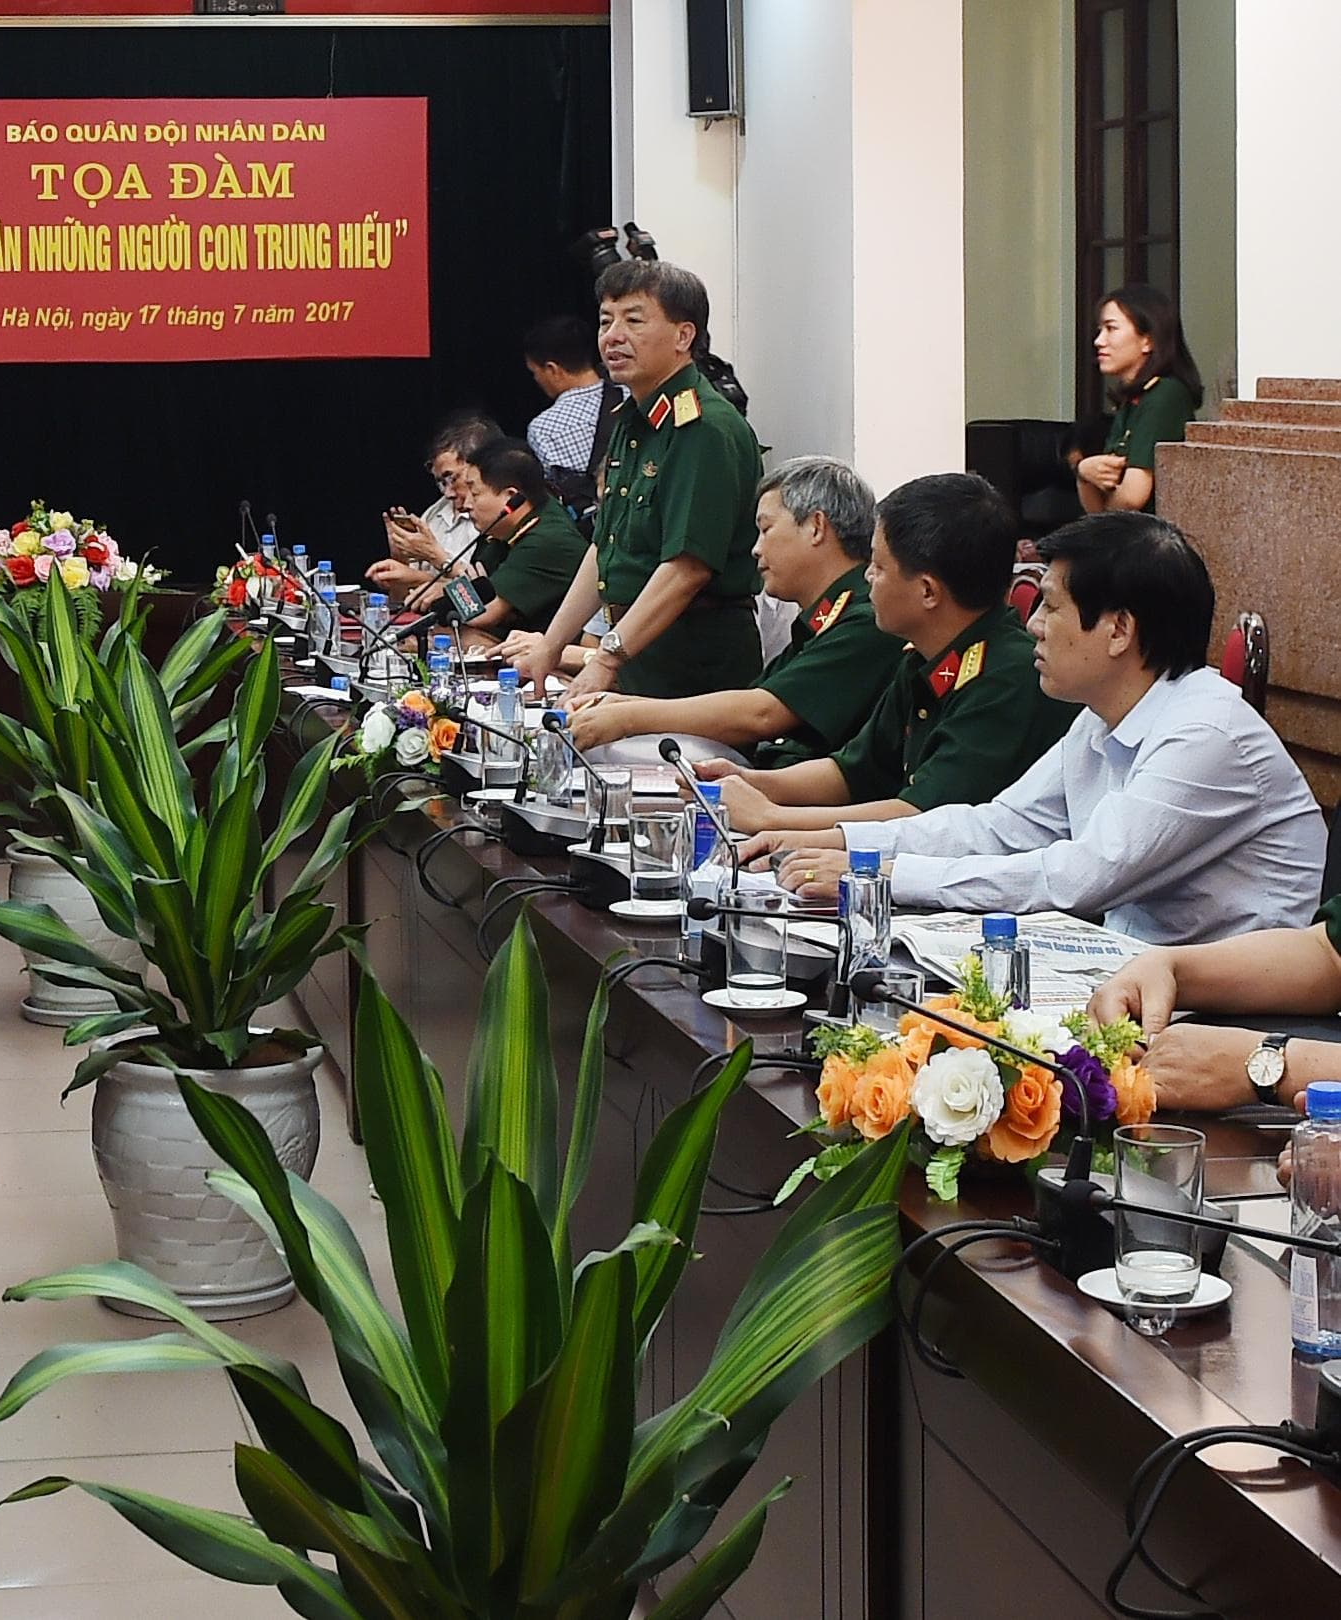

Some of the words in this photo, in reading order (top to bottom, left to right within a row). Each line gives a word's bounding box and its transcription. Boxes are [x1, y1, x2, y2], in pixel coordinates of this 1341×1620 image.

[6, 120, 58, 143] BÁO
[65, 121, 137, 143] QUÂN
[144, 120, 187, 147] ĐỘI
[195, 119, 265, 142] NHÂN
[271, 120, 325, 141] DÂN
[31, 162, 152, 208] TỌA
[168, 152, 294, 200] ĐÀM
[28, 215, 111, 272] NHỮNG
[118, 213, 191, 271] NGƯỜI
[198, 223, 247, 271] CON
[254, 222, 331, 270] TRUNG
[1, 307, 30, 327] Hà
[35, 306, 74, 331] Nội,
[81, 307, 132, 331] ngày
[139, 304, 161, 325] 17
[167, 304, 225, 331] tháng
[233, 304, 246, 324] 7
[251, 303, 295, 323] năm
[305, 301, 354, 322] 2017
